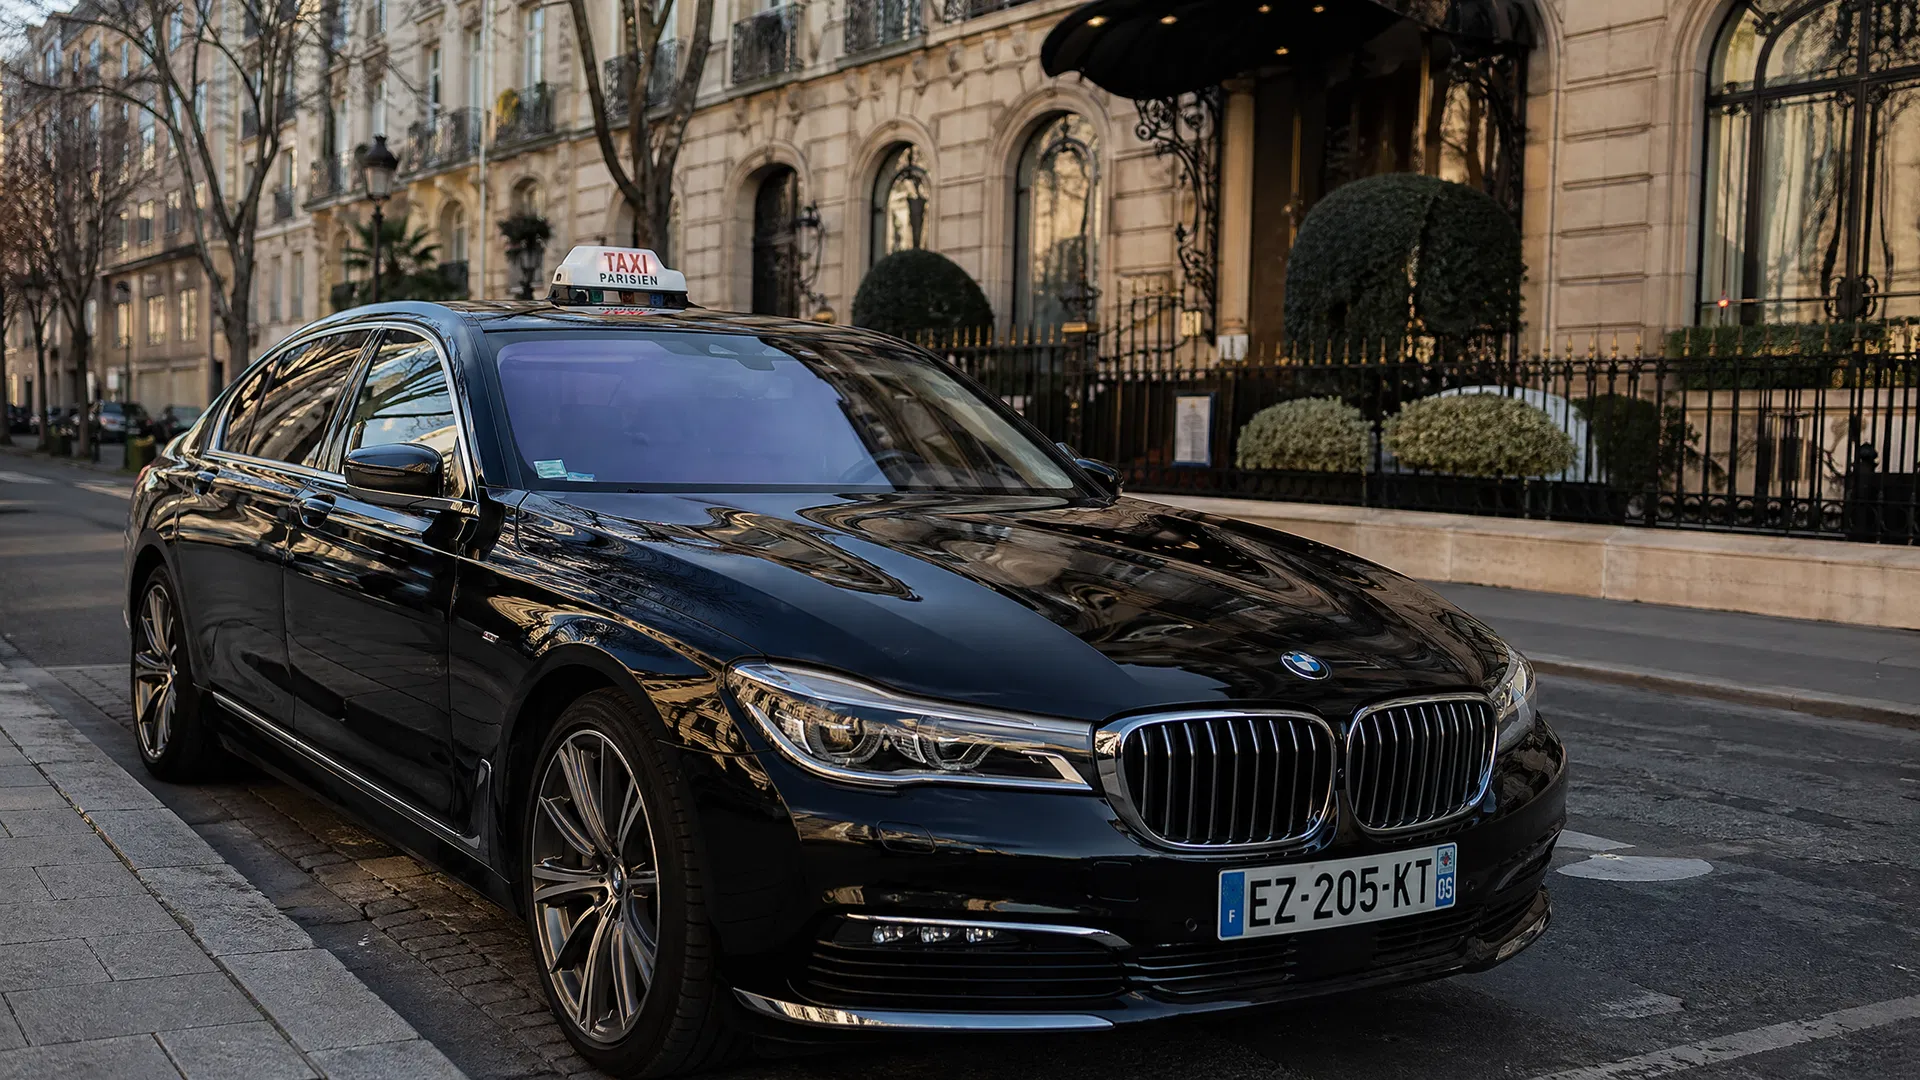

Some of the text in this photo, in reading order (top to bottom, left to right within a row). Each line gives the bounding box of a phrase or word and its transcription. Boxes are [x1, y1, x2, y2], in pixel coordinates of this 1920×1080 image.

[603, 252, 648, 274] TAXI
[599, 273, 658, 286] PARISIEN
[1249, 858, 1432, 928] EZ-205-KT
[1228, 909, 1236, 924] F
